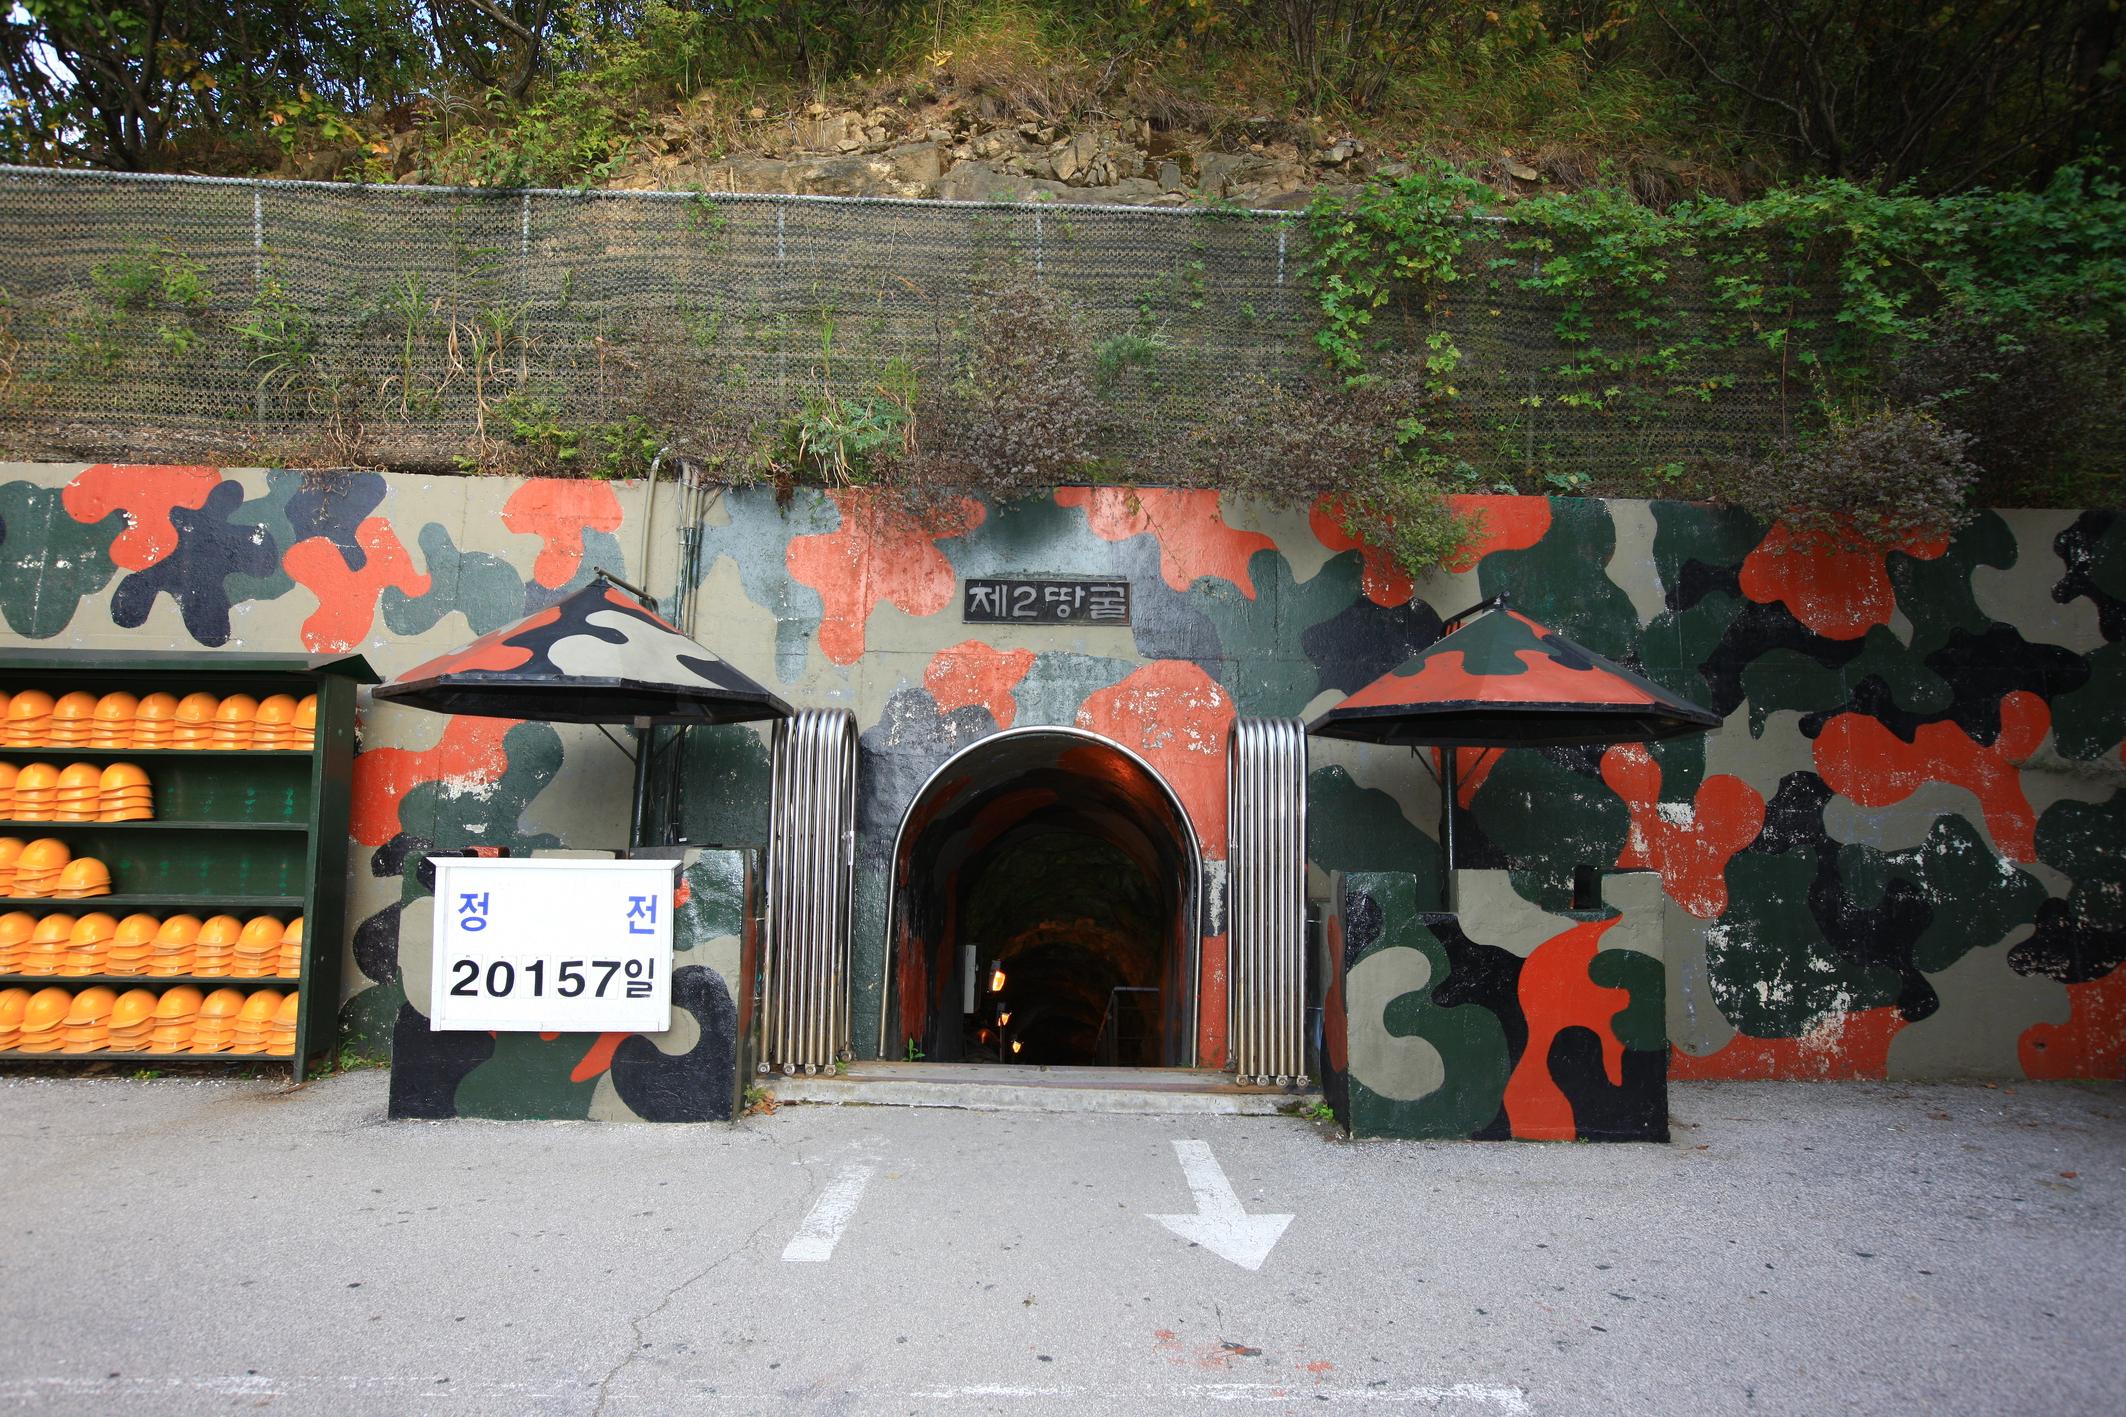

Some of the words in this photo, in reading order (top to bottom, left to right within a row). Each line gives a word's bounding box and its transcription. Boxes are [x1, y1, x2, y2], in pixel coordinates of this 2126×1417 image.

[968, 584, 1127, 619] 제2땅굴
[458, 892, 489, 932] 정
[626, 895, 658, 935] 전
[450, 958, 654, 998] 20157일
